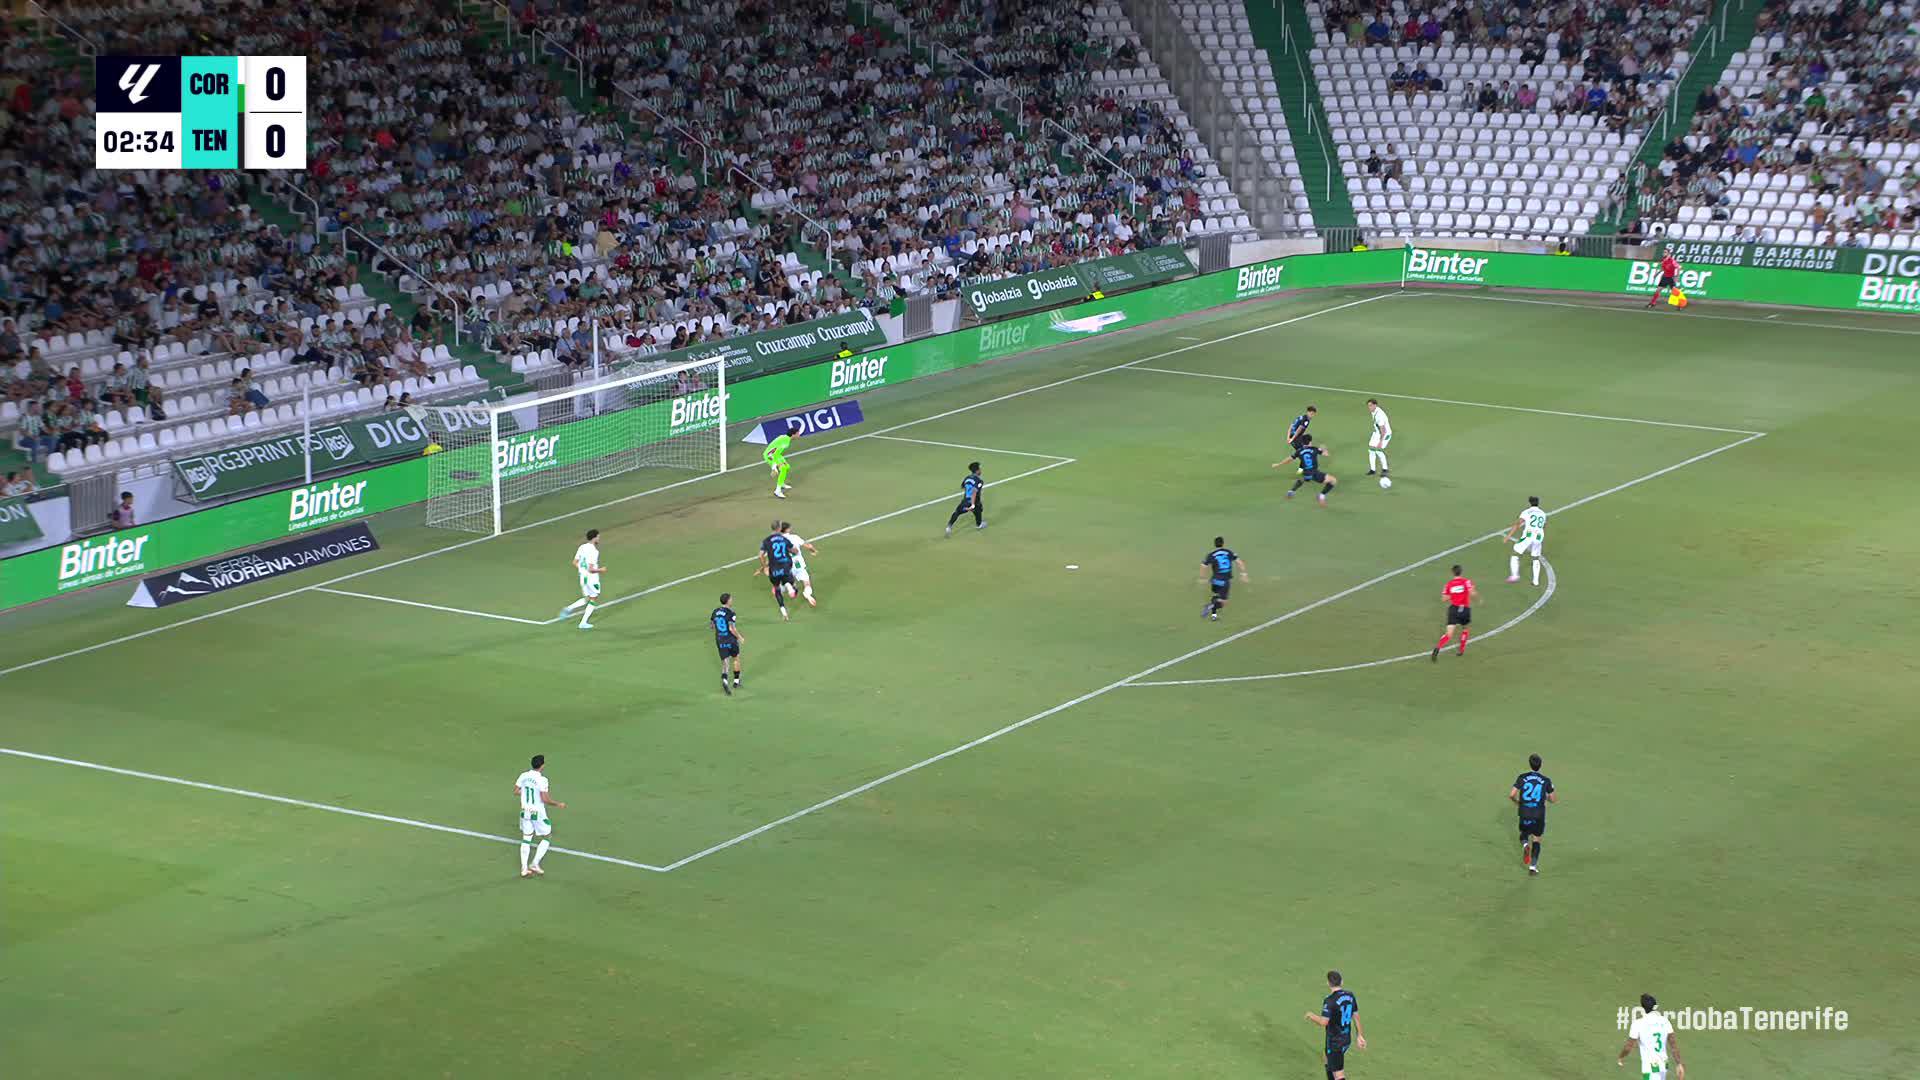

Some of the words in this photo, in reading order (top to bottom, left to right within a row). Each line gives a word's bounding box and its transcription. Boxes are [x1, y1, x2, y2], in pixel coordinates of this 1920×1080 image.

[1408, 249, 1489, 275] Binter
[1666, 243, 1744, 257] BAHRAIN
[1754, 246, 1838, 260] BAHRAIN
[1670, 254, 1742, 265] ICTORIOUS
[1752, 258, 1835, 270] VICTORIOUS
[1237, 265, 1284, 291] Binter
[1859, 275, 1920, 303] Bint
[971, 286, 1023, 313] globalzia
[1027, 274, 1078, 300] globalzia
[756, 332, 817, 356] Cruzcampo
[817, 319, 875, 341] Cruzcampo
[979, 323, 1030, 352] Binter
[830, 355, 888, 388] Binter
[786, 406, 842, 435] DIGI
[206, 434, 324, 474] RG3PRINT.ES
[498, 434, 560, 469] Binter
[290, 480, 367, 521] Binter
[1530, 514, 1544, 528] 28
[59, 534, 149, 580] Binter
[210, 556, 296, 588] MORENA
[294, 535, 372, 565] JAMONES
[772, 542, 786, 558] 27
[206, 554, 263, 577] SIERRA
[525, 786, 535, 804] 11
[1522, 782, 1543, 802] 24
[1341, 1004, 1353, 1026] 14
[1653, 1032, 1662, 1053] 3
